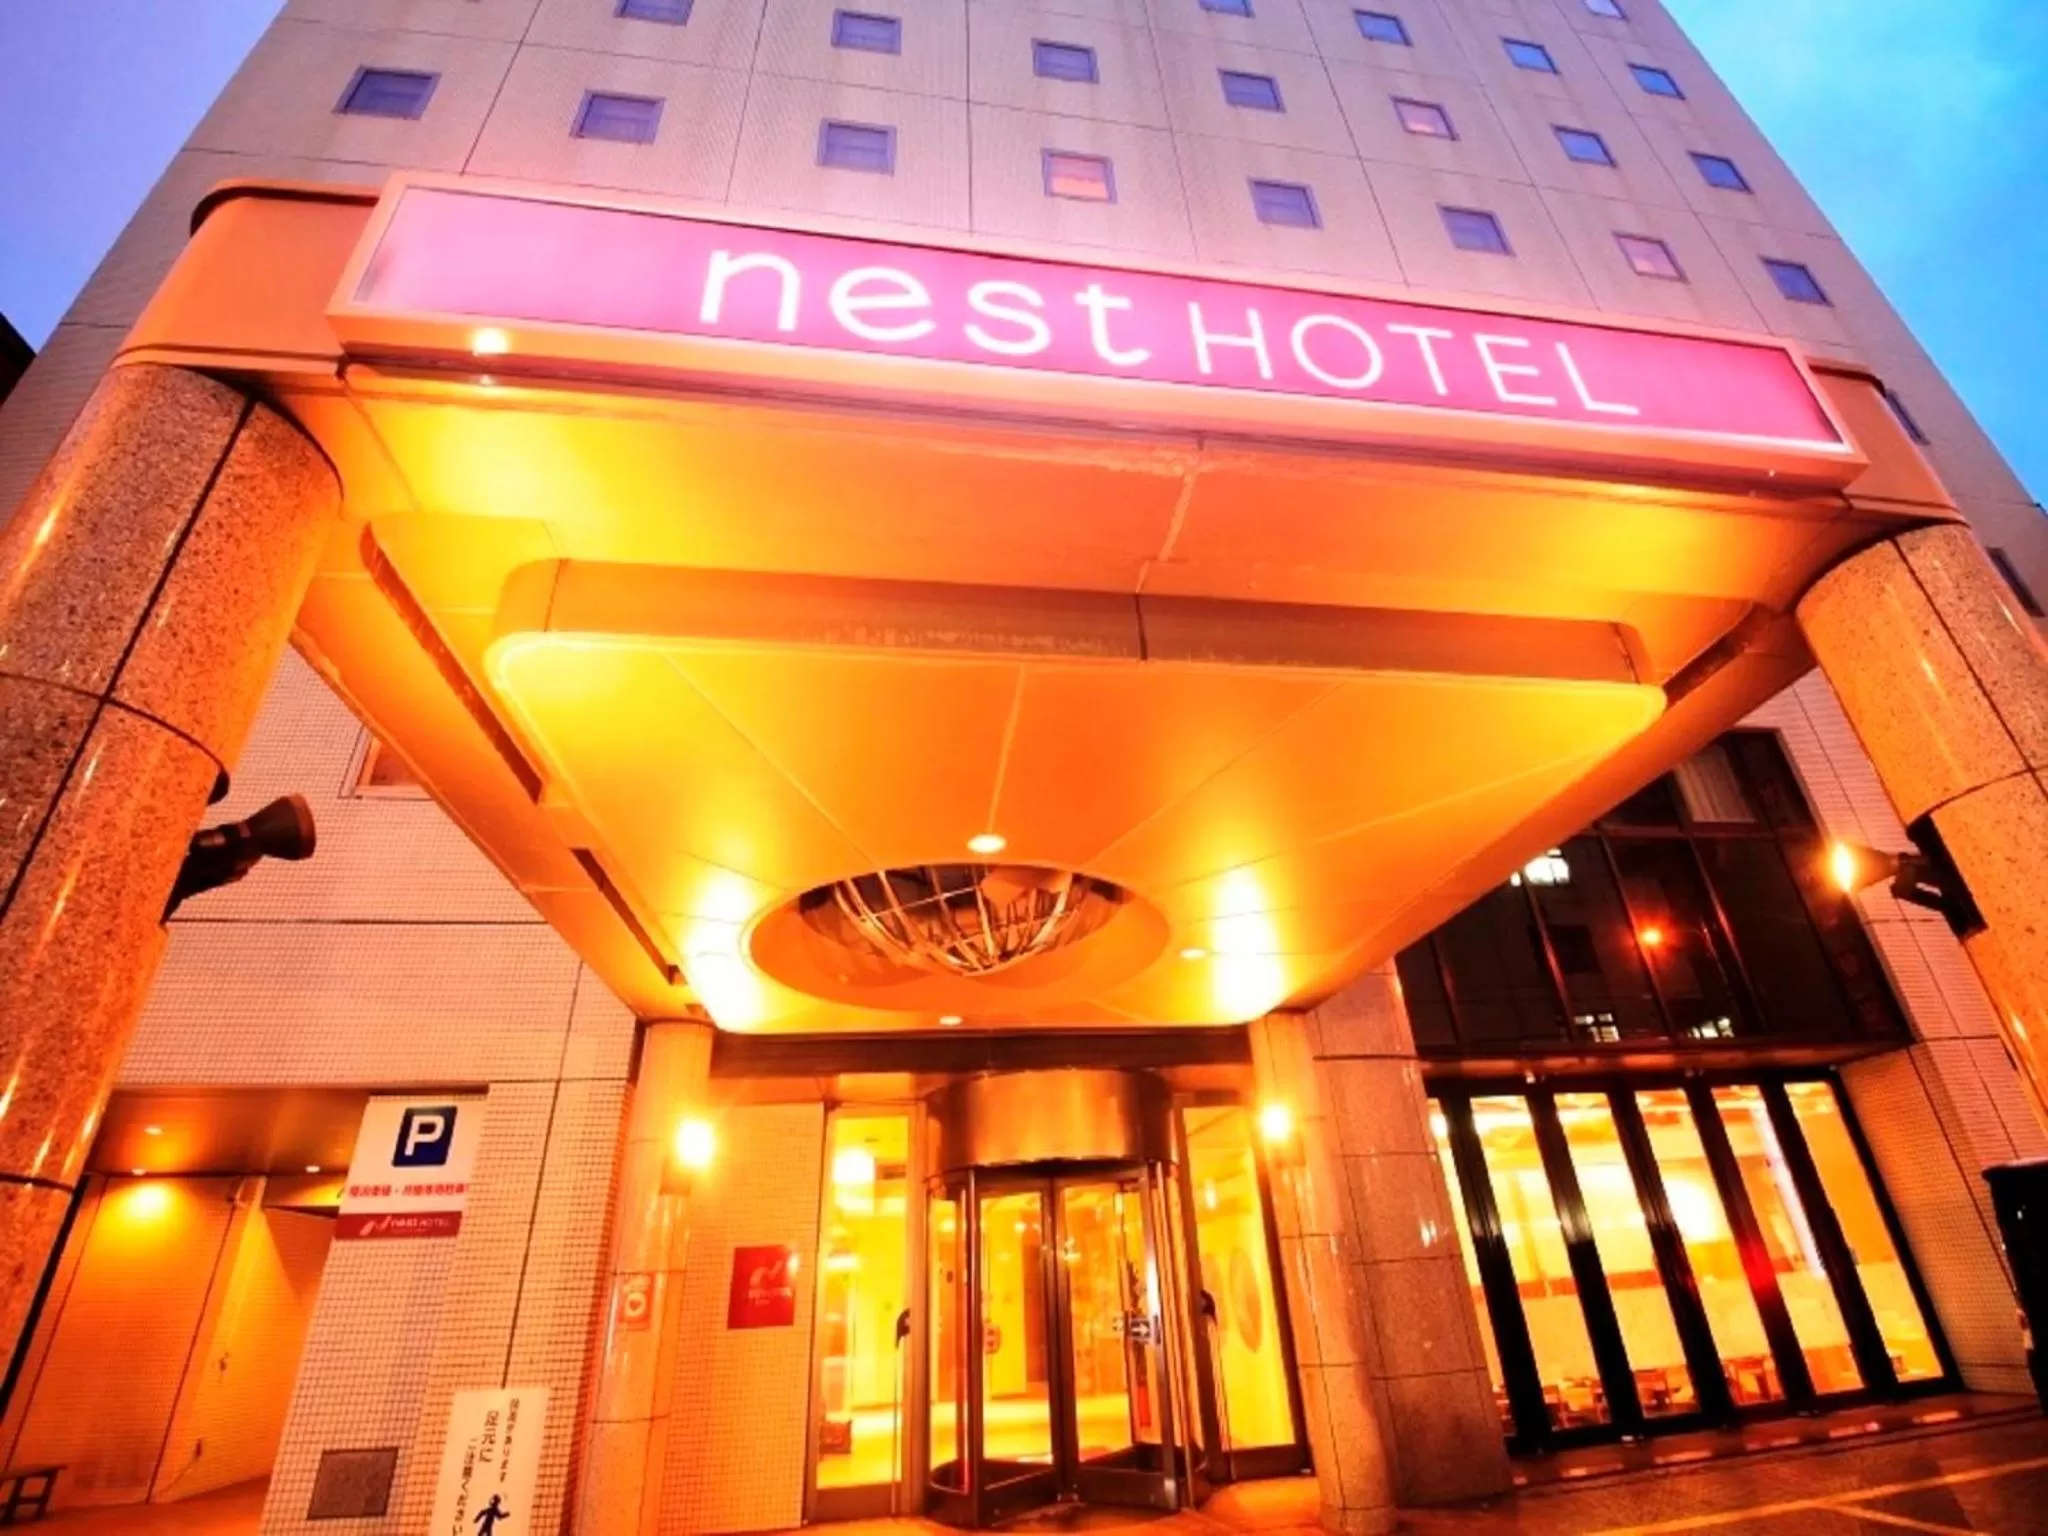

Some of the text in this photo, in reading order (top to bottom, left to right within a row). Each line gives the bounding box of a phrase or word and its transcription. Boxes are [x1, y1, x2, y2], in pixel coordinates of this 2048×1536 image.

[701, 249, 1639, 416] nest HOTEL
[404, 1114, 444, 1156] P
[478, 1410, 500, 1463] 足元に
